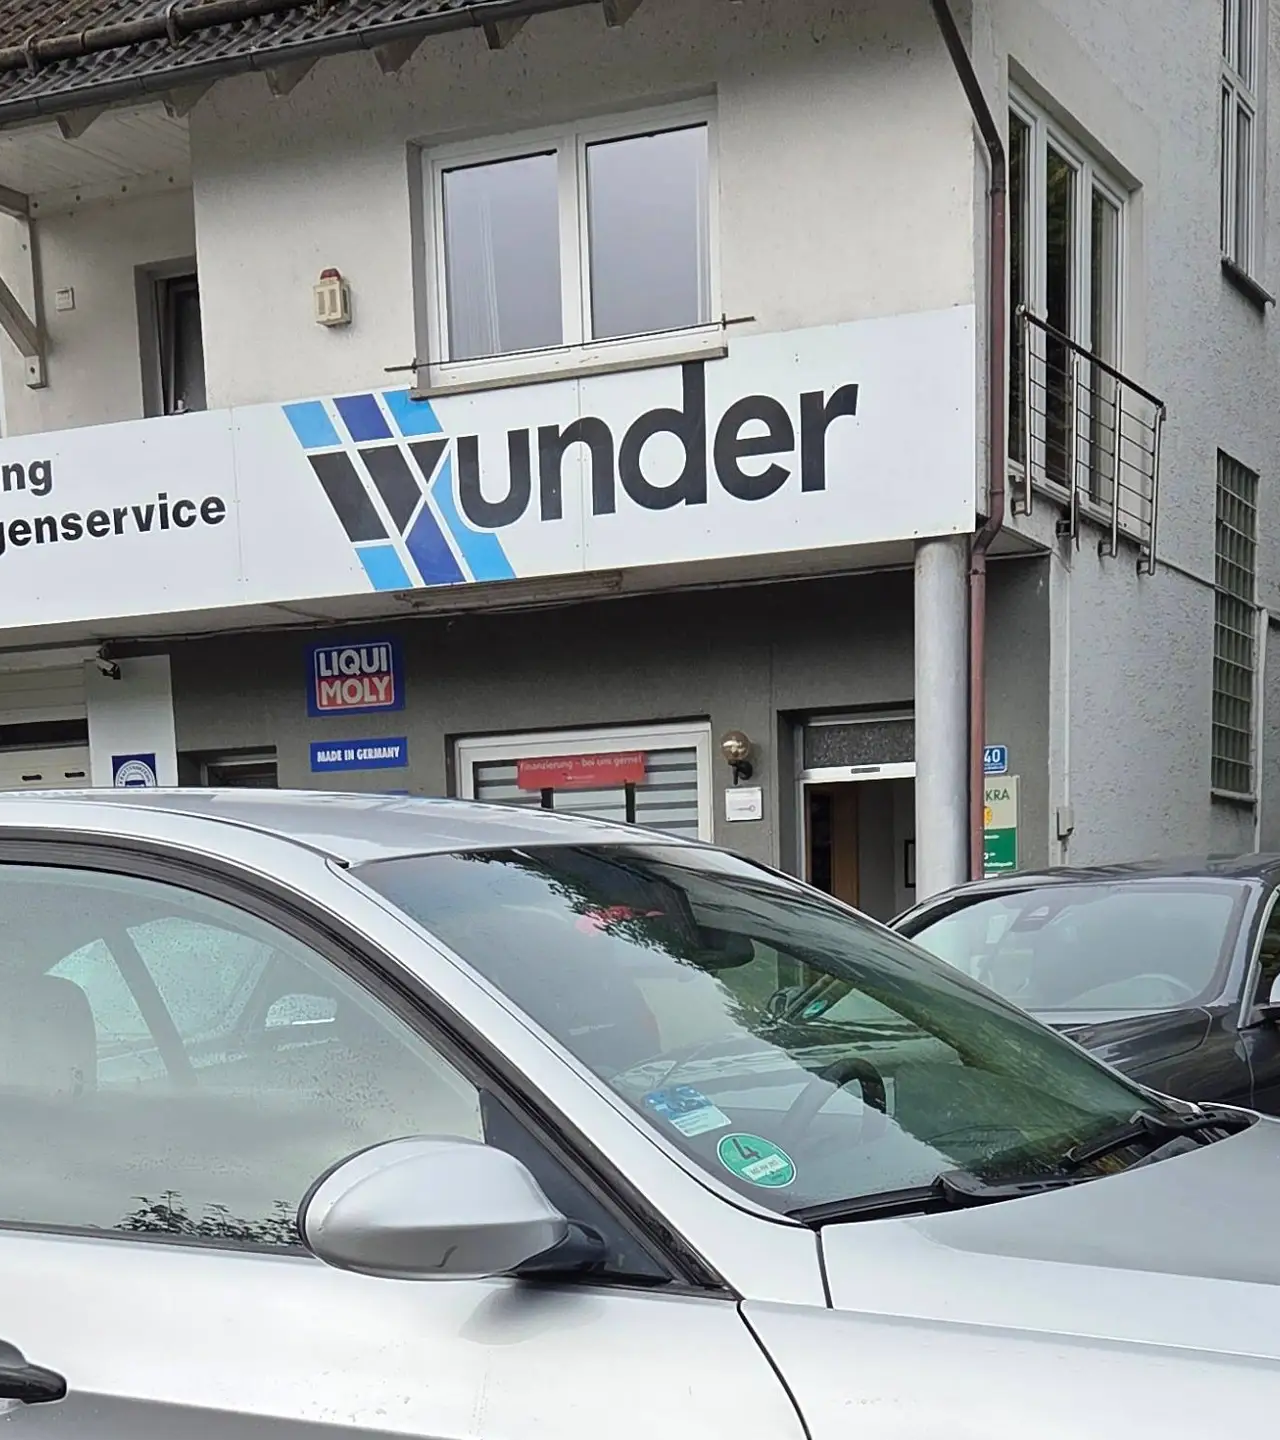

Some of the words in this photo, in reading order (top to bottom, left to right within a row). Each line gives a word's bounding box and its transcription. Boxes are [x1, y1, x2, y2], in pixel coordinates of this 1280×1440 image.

[283, 360, 858, 590] Wunder
[318, 646, 388, 677] LIQUI
[319, 675, 390, 706] MOLY
[317, 749, 342, 763] MADE
[344, 748, 355, 761] IN
[356, 745, 400, 761] GERMANY
[519, 760, 573, 773] Finanzierung
[985, 788, 1010, 802] KRA
[732, 1138, 760, 1160] 4
